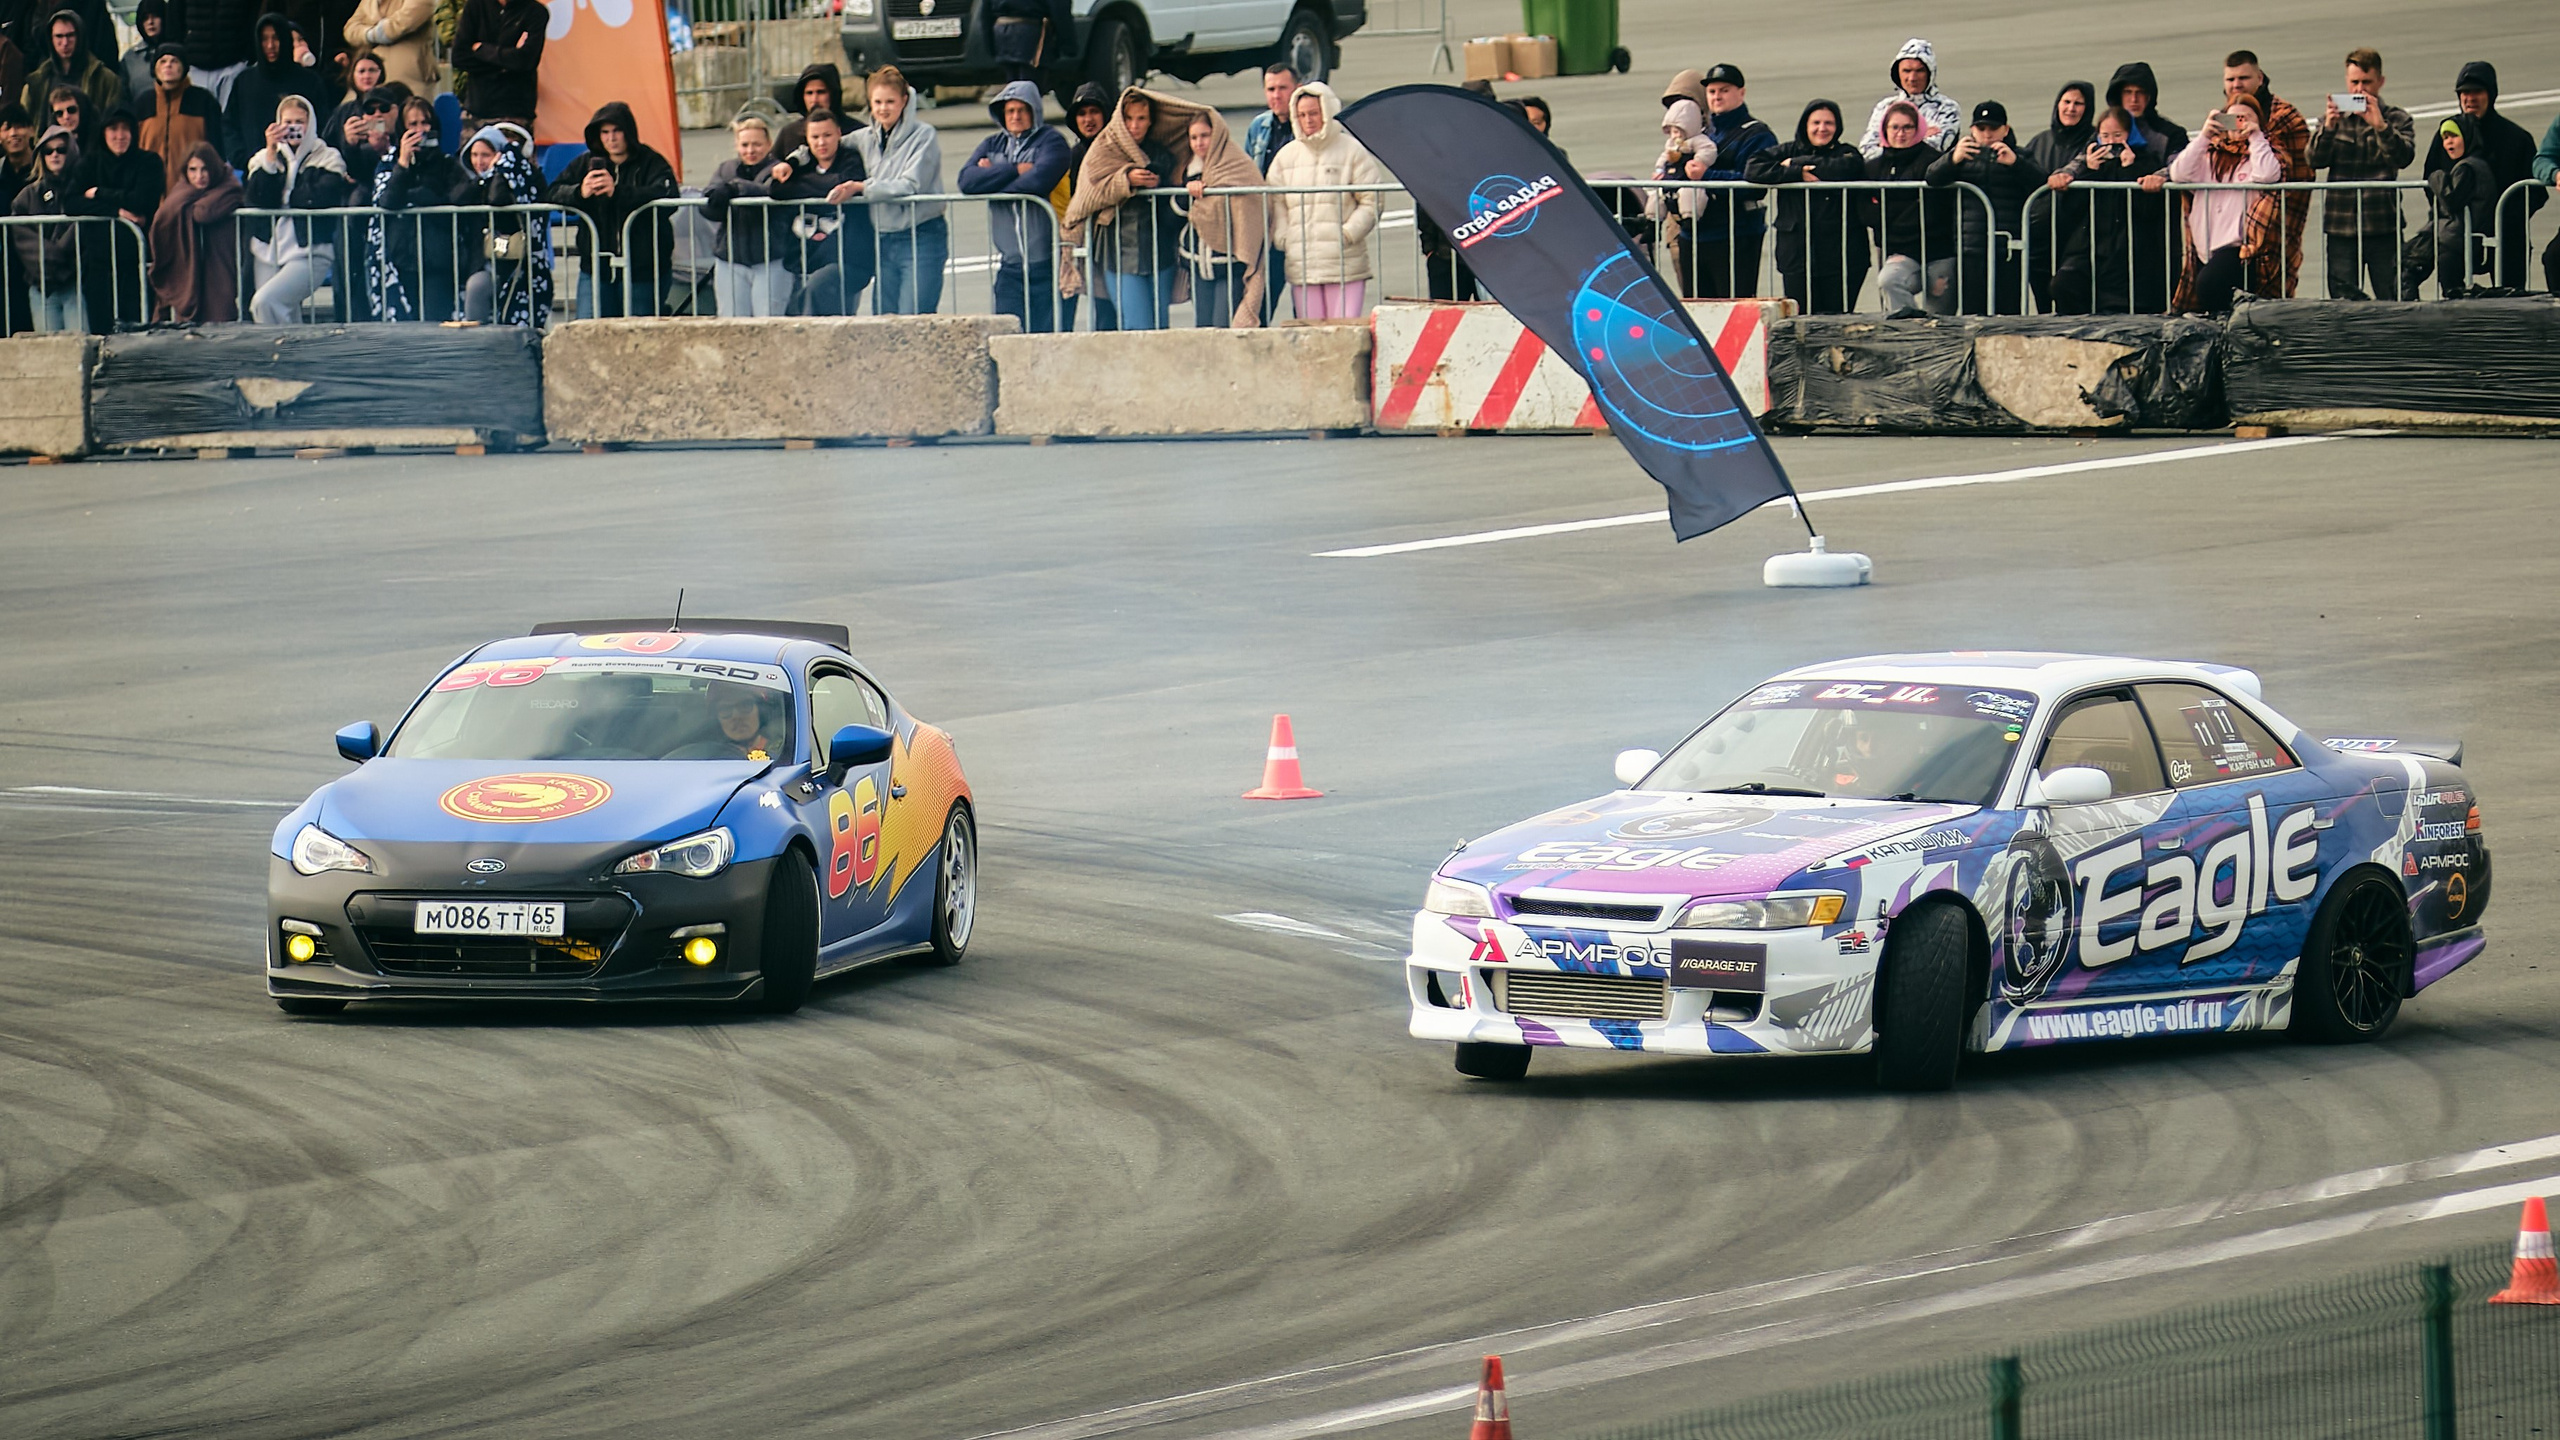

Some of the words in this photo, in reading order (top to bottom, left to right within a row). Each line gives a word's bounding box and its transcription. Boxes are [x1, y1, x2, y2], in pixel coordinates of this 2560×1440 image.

[667, 661, 759, 680] TRD
[530, 699, 579, 709] RECARO
[829, 775, 881, 899] 86
[1517, 841, 1745, 871] Eagle
[2074, 793, 2318, 968] Eagle
[1736, 961, 1758, 973] JET
[2028, 999, 2223, 1039] www.eagle-oil.ru
